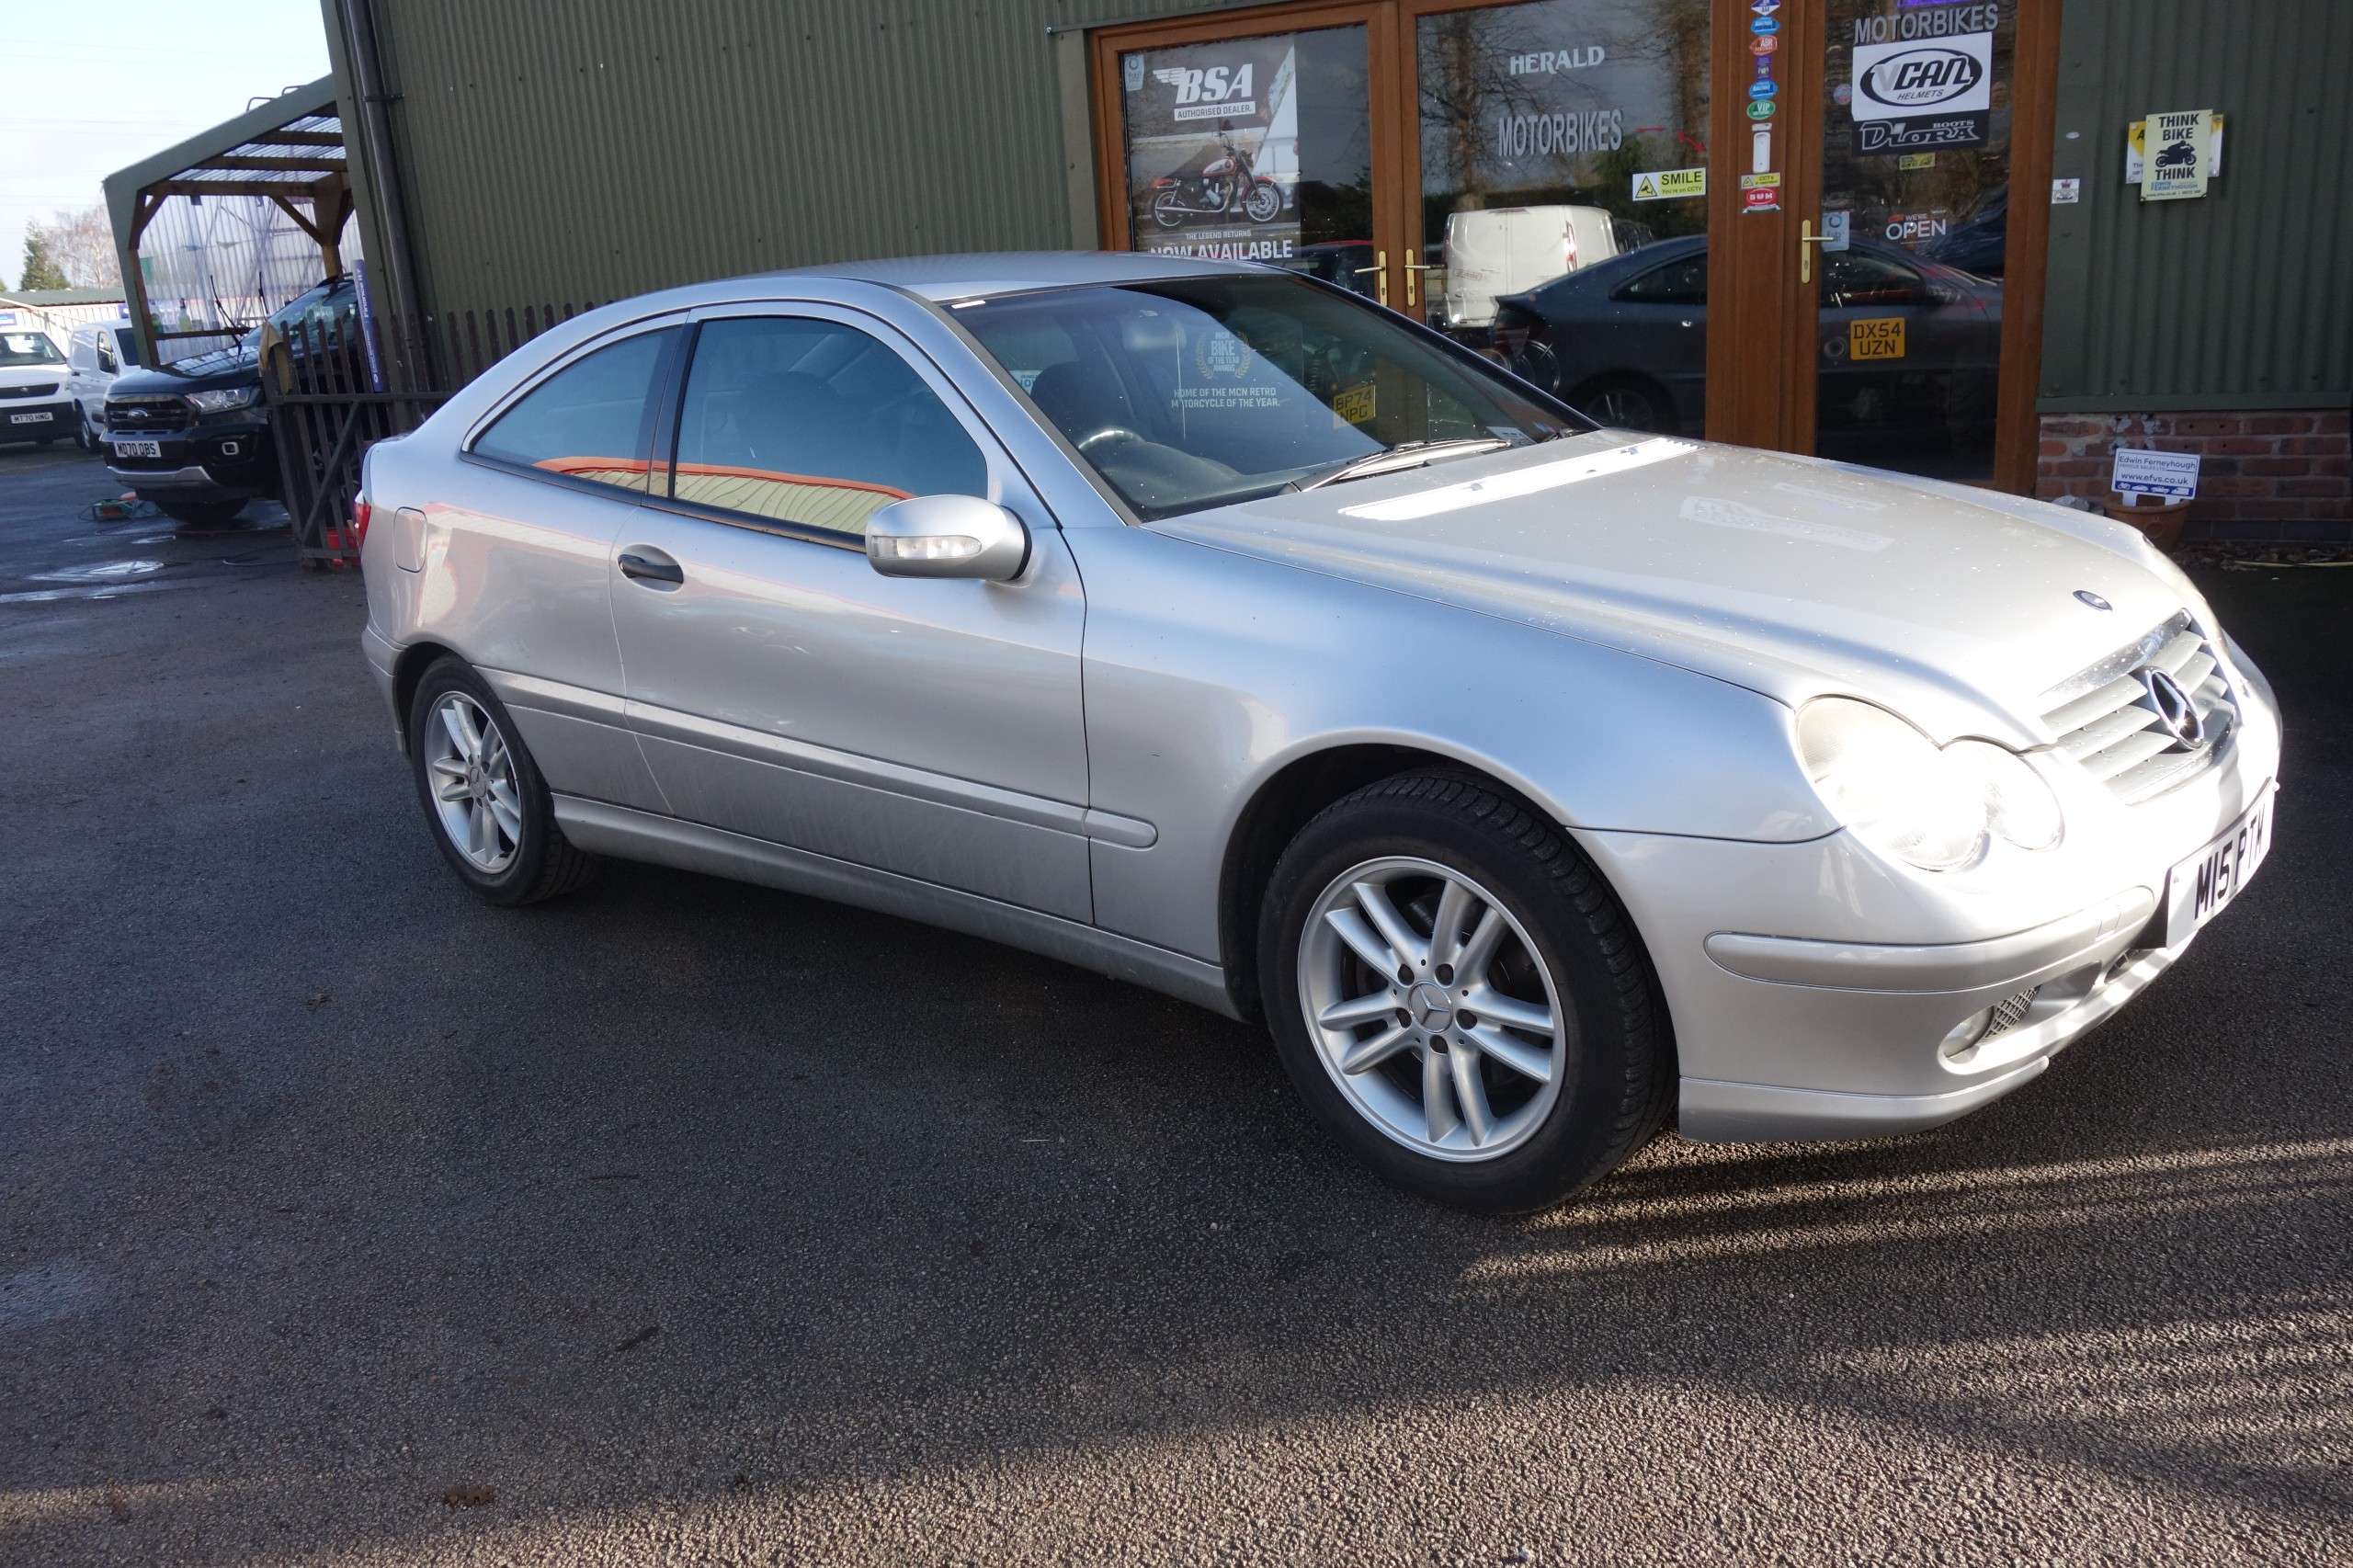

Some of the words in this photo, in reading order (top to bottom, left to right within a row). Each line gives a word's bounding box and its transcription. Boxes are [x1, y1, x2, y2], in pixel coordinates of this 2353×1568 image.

[1854, 4, 1998, 44] MOTORBIKES
[1510, 46, 1605, 75] HERALD
[1874, 56, 1973, 91] VCAN
[1175, 62, 1253, 104] BSA
[1896, 89, 1944, 101] HELMETS
[1176, 107, 1222, 119] AUTHORISED
[1933, 119, 1974, 129] BOOTS
[2158, 113, 2200, 128] THINK
[1498, 109, 1623, 156] MOTORBIKES
[2163, 128, 2194, 141] BIKE
[1661, 171, 1702, 185] SMILE
[2154, 166, 2196, 180] THINK
[1199, 231, 1222, 240] LEGEND
[1223, 230, 1252, 238] RETURNS
[1885, 219, 1947, 241] OPEN
[1198, 240, 1293, 261] AVAILABLE
[1853, 322, 1902, 339] DX54
[1211, 340, 1235, 356] BIKE
[1859, 339, 1896, 356] UZN
[1174, 388, 1198, 398] HOME
[1199, 388, 1210, 397] OF
[1211, 388, 1226, 397] THE
[1229, 387, 1248, 396] MCN
[1250, 387, 1277, 396] RETRO
[1171, 399, 1223, 408] MTORCYCLE
[1226, 398, 1236, 407] OF
[1239, 398, 1254, 406] THE
[1336, 389, 1370, 411] BP74
[139, 442, 156, 456] OBS
[2119, 455, 2143, 464] Edwin
[2121, 472, 2188, 485] www.efvs.co.uk
